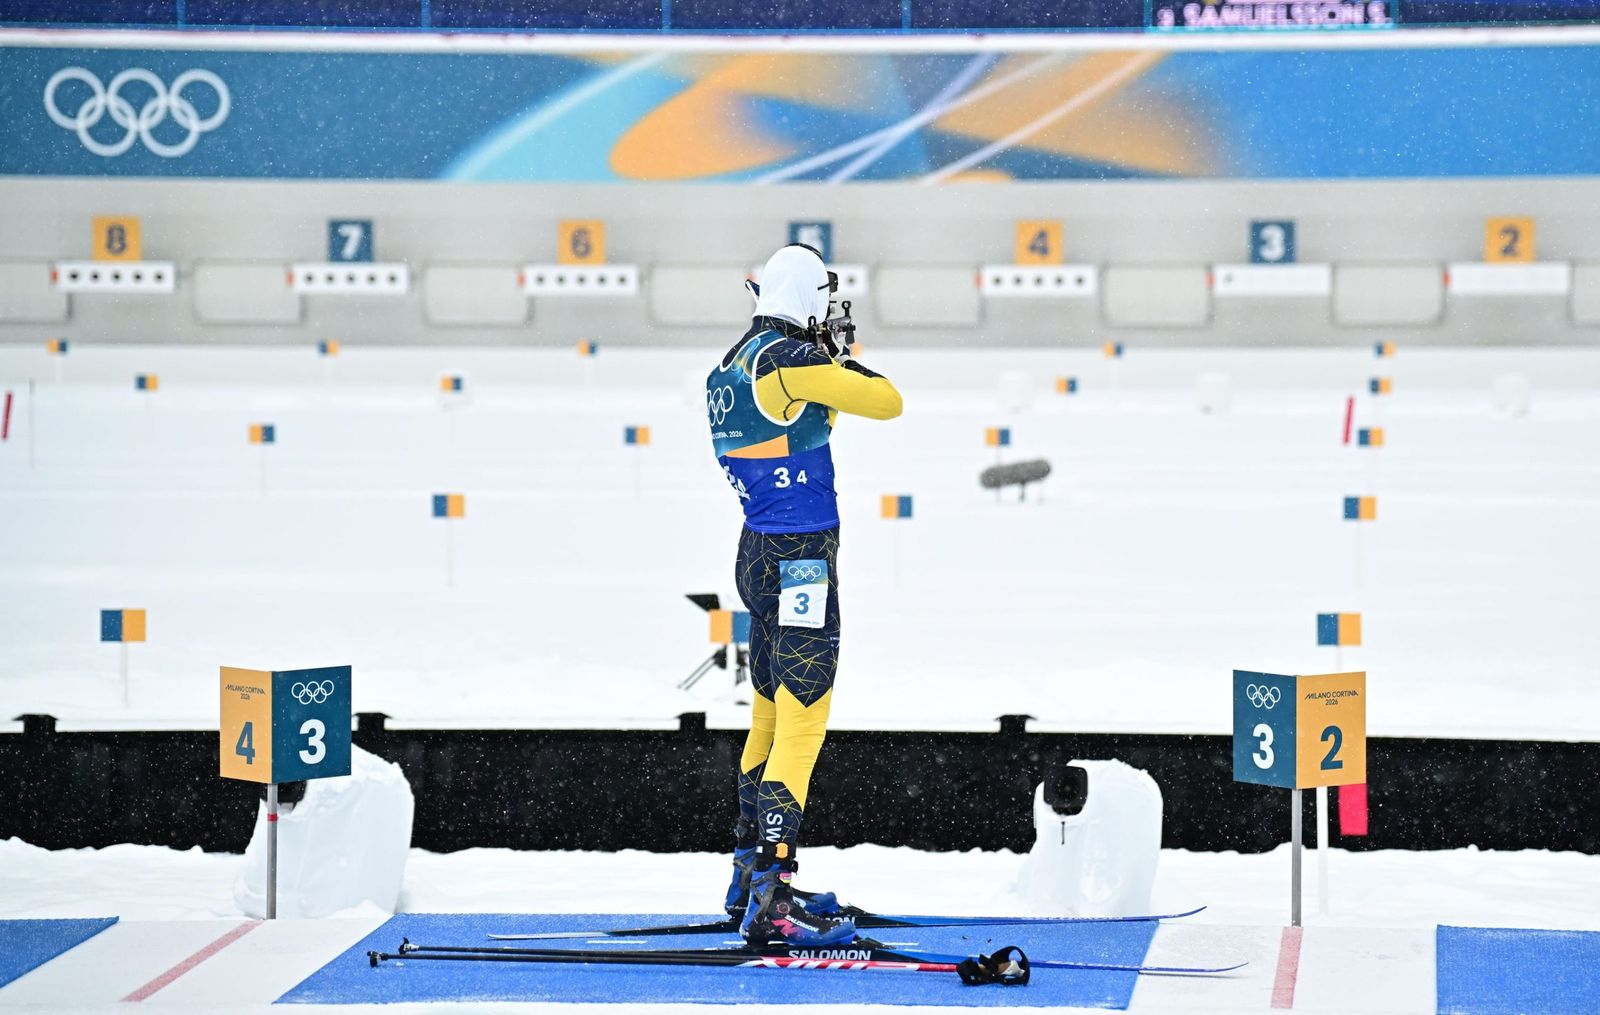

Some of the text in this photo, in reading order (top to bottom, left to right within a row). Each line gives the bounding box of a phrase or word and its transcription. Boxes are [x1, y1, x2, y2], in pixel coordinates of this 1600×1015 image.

[1184, 2, 1365, 27] SAMUELSSON
[106, 223, 127, 256] 8
[338, 223, 362, 260] 7
[571, 227, 592, 258] 6
[1029, 230, 1049, 257] 4
[1259, 224, 1285, 261] 3
[1500, 225, 1519, 257] 2
[729, 430, 743, 438] 2026
[774, 467, 808, 488] 3 4
[793, 592, 810, 615] 3
[1304, 690, 1359, 700] MILANO CORTINA
[1325, 698, 1338, 706] 2026
[235, 721, 256, 765] 4
[299, 718, 326, 765] 3
[1252, 723, 1275, 770] 3
[1320, 725, 1343, 771] 2
[785, 914, 819, 933] SALOMON
[788, 949, 872, 961] SALOMON
